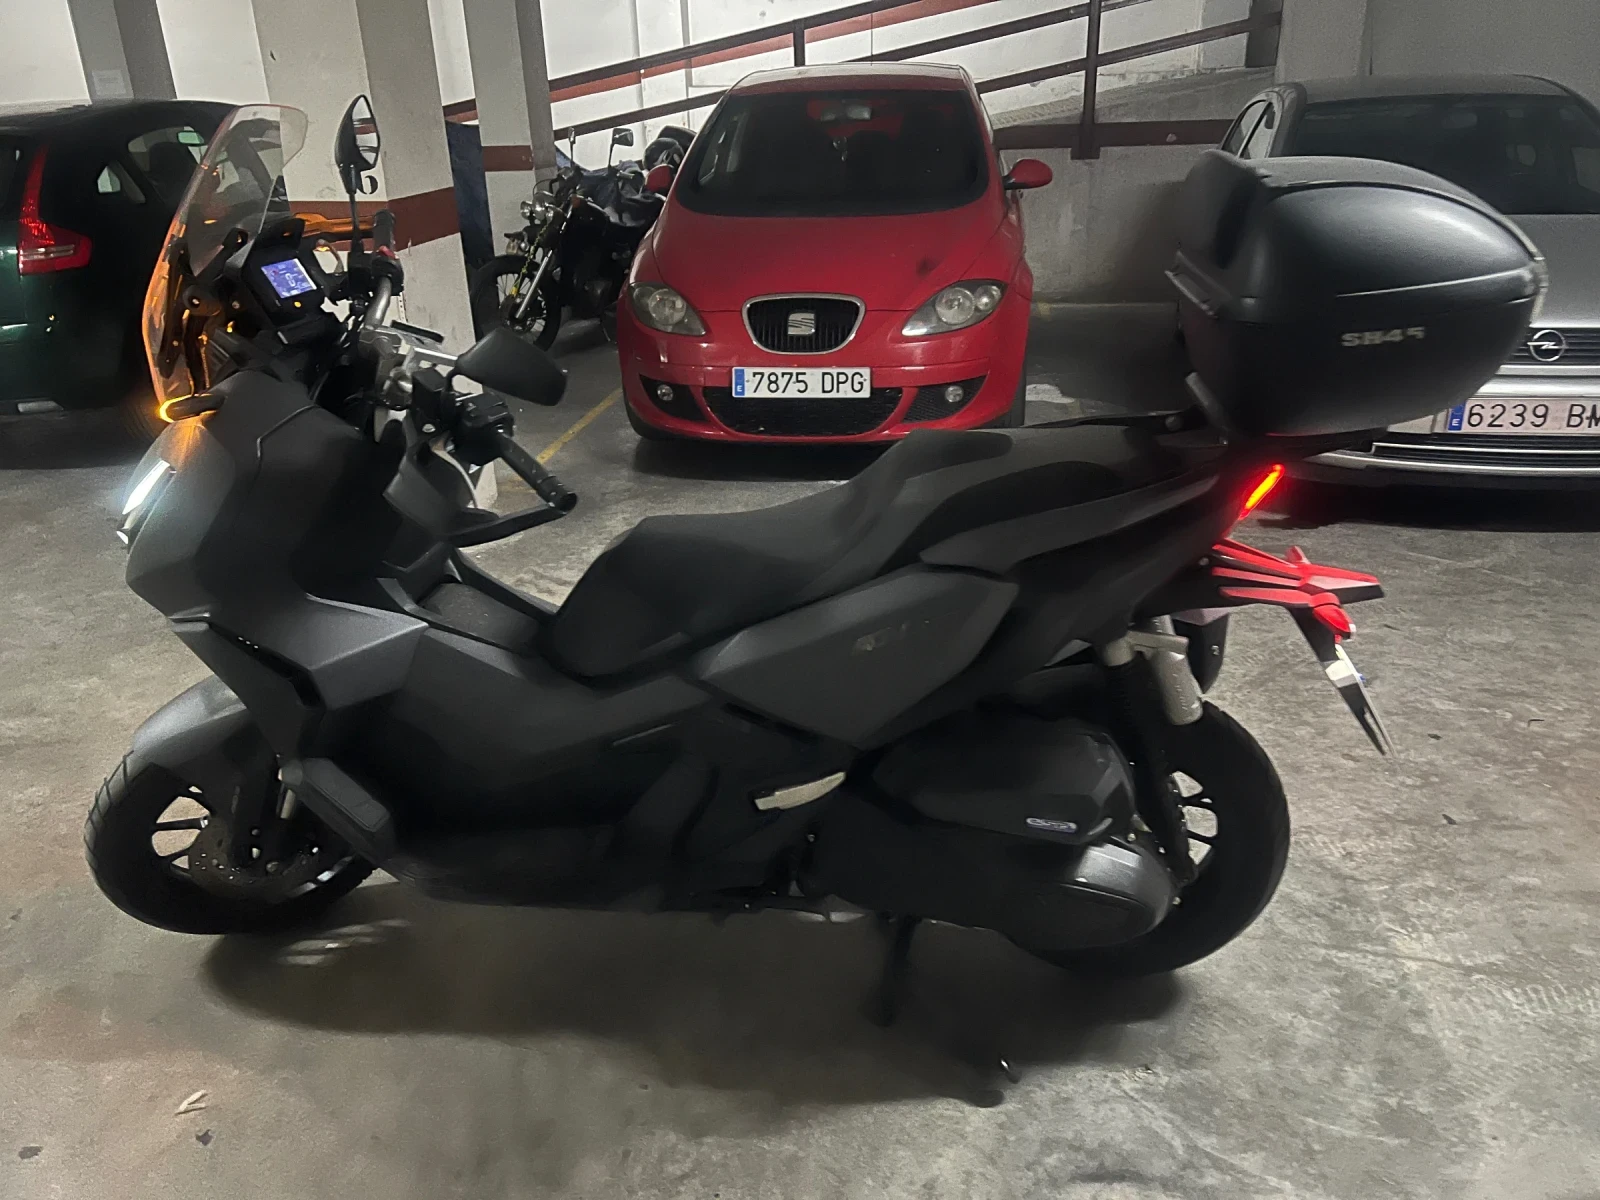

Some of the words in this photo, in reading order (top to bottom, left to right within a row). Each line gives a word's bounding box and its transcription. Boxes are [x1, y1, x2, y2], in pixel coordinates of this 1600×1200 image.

[752, 371, 809, 394] 7875
[821, 371, 865, 394] DPG
[1451, 418, 1460, 426] E
[1467, 403, 1549, 428] 6239
